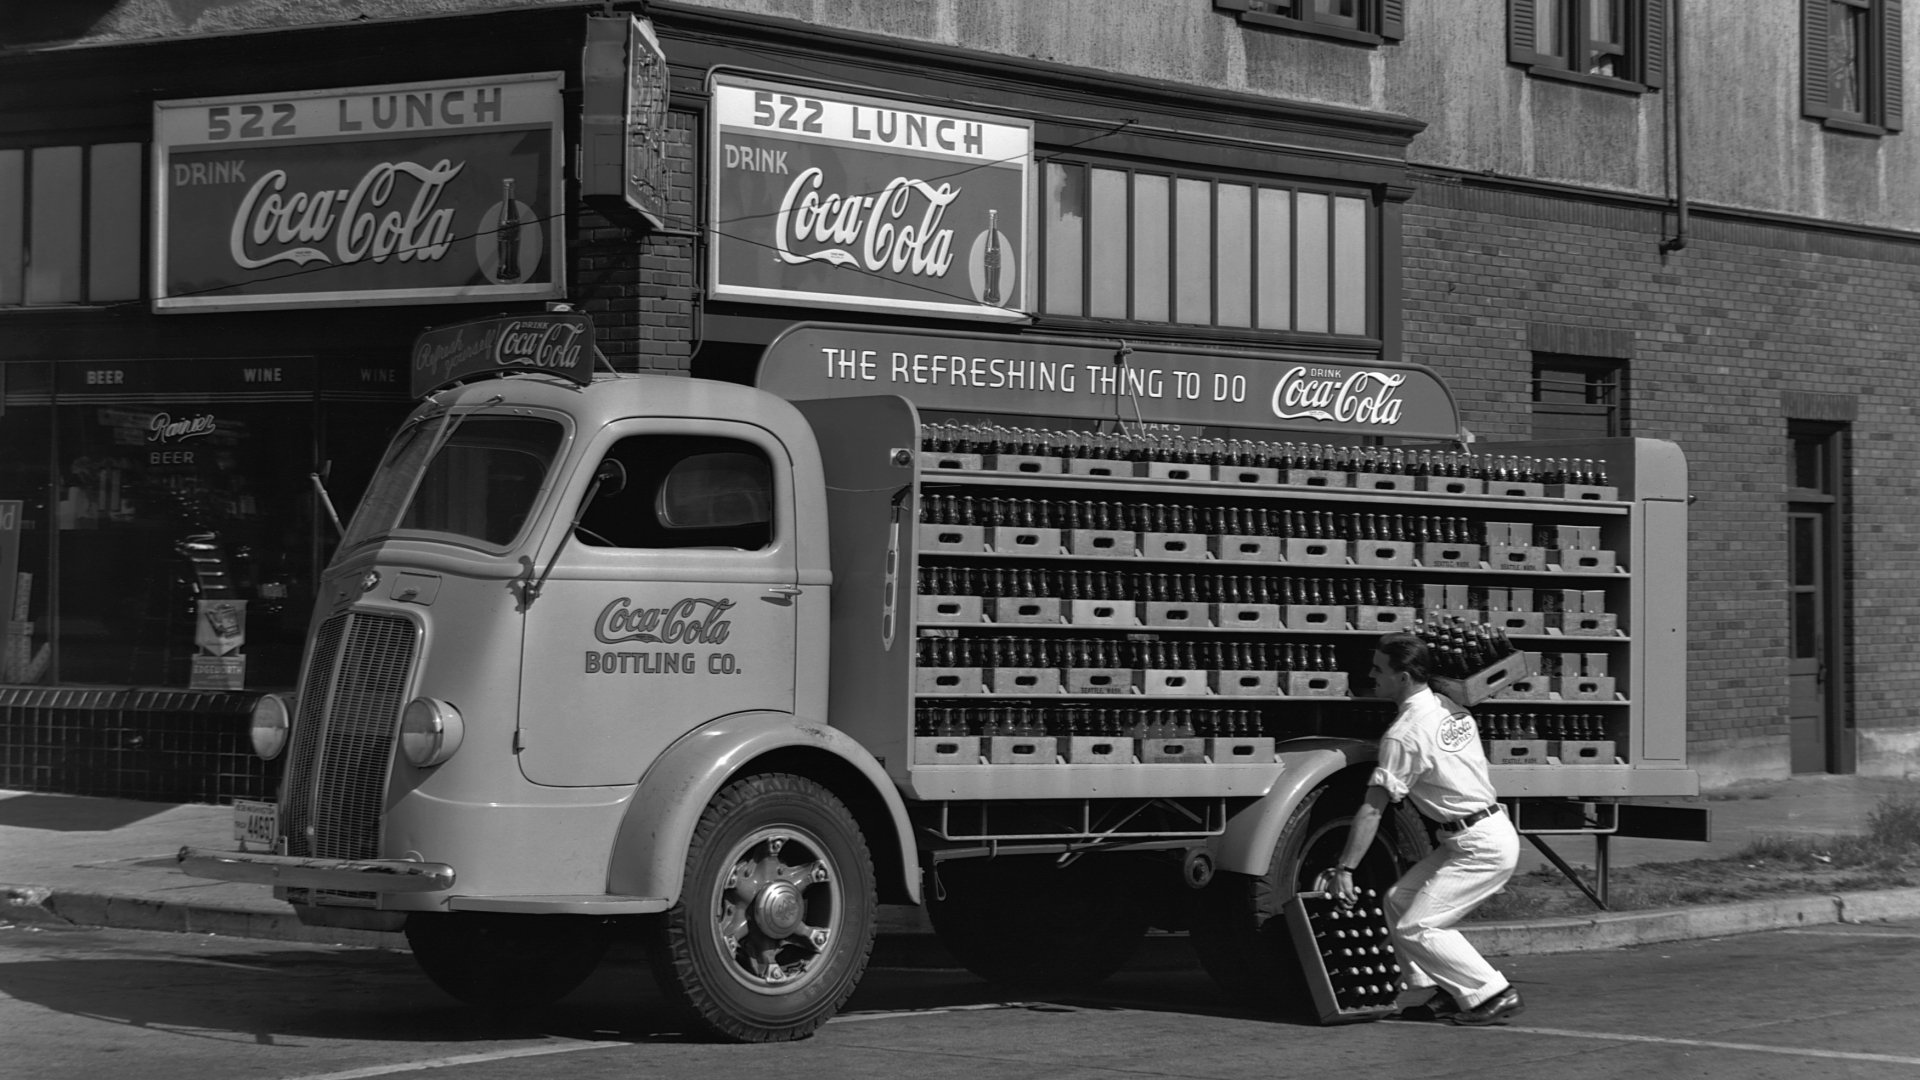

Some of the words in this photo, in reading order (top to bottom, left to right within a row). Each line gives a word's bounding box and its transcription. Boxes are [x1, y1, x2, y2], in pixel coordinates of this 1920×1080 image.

[208, 103, 296, 140] 522
[339, 88, 502, 132] LUNCH
[754, 91, 824, 134] 522
[852, 106, 983, 155] LUNCH
[174, 160, 246, 186] DRINK
[724, 144, 789, 175] DRINK
[230, 159, 466, 269] Coca-Cola
[776, 167, 962, 277] Coca-Cola
[521, 321, 549, 330] DRINK
[495, 321, 585, 368] Coca-Cola
[86, 370, 125, 385] BEER
[243, 368, 283, 382] WINE
[360, 368, 396, 382] WINE
[821, 348, 877, 381] THE
[891, 352, 1075, 393] REFRESHING
[1086, 365, 1163, 398] THING
[1172, 371, 1200, 399] TO
[1213, 374, 1246, 403] DO
[1310, 368, 1342, 378] DRINK
[1271, 366, 1407, 425] Coca-Cola
[147, 412, 216, 443] Rainier
[150, 451, 195, 464] BEER
[594, 597, 738, 645] Coca-Cola
[585, 651, 696, 674] BOTTLING
[708, 653, 742, 675] CO.
